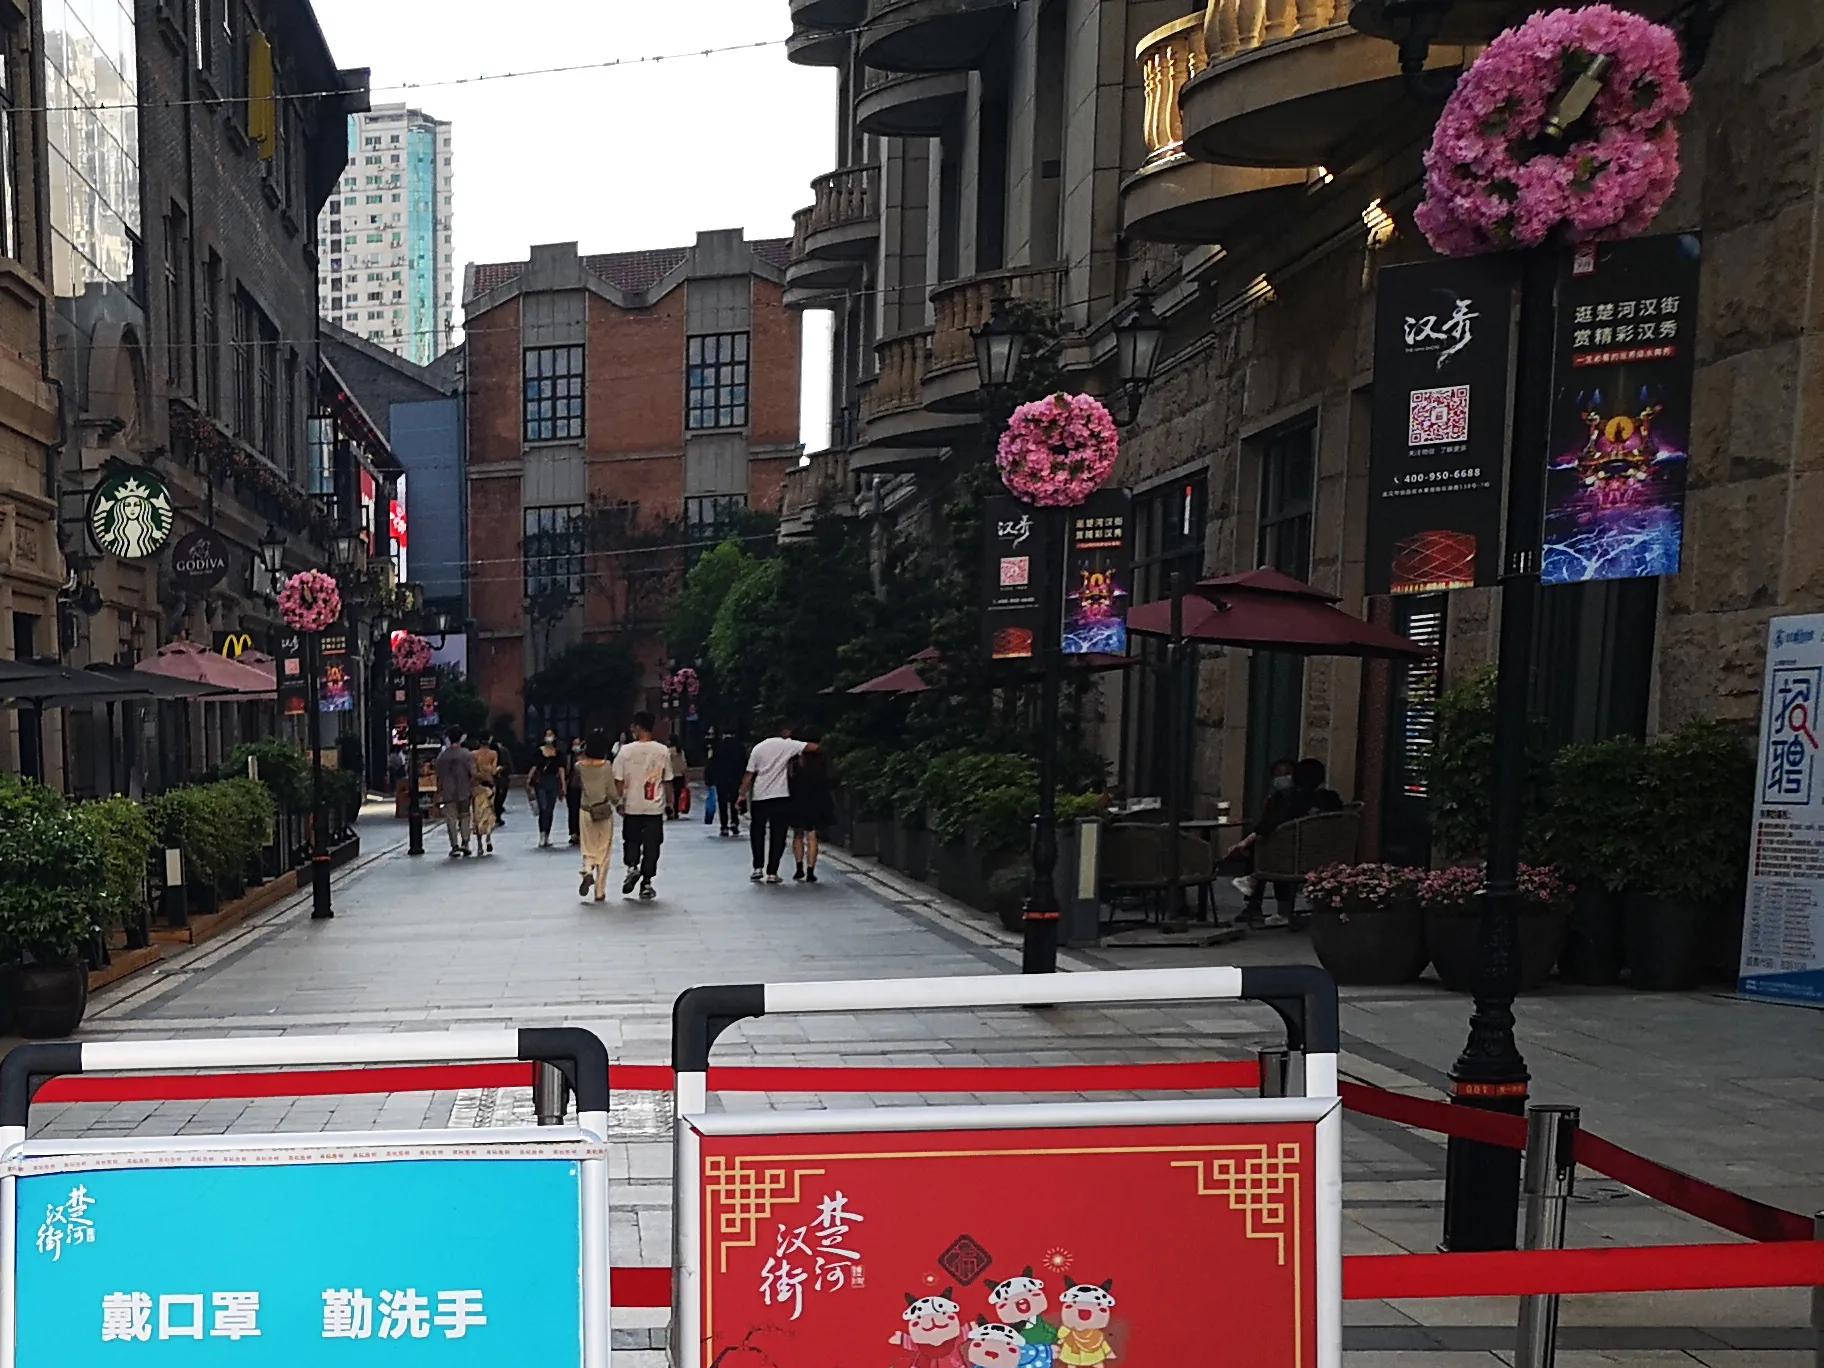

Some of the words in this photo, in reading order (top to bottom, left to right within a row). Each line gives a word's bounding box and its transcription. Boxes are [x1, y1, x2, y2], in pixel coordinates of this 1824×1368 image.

[1574, 295, 1681, 324] 逛楚河汉街
[1572, 319, 1678, 349] 赏精彩汉秀
[1404, 468, 1481, 483] 400-950-6688
[176, 557, 225, 571] GODIVA
[100, 1290, 262, 1342] 戴口罩
[320, 1288, 488, 1340] 勤洗手
